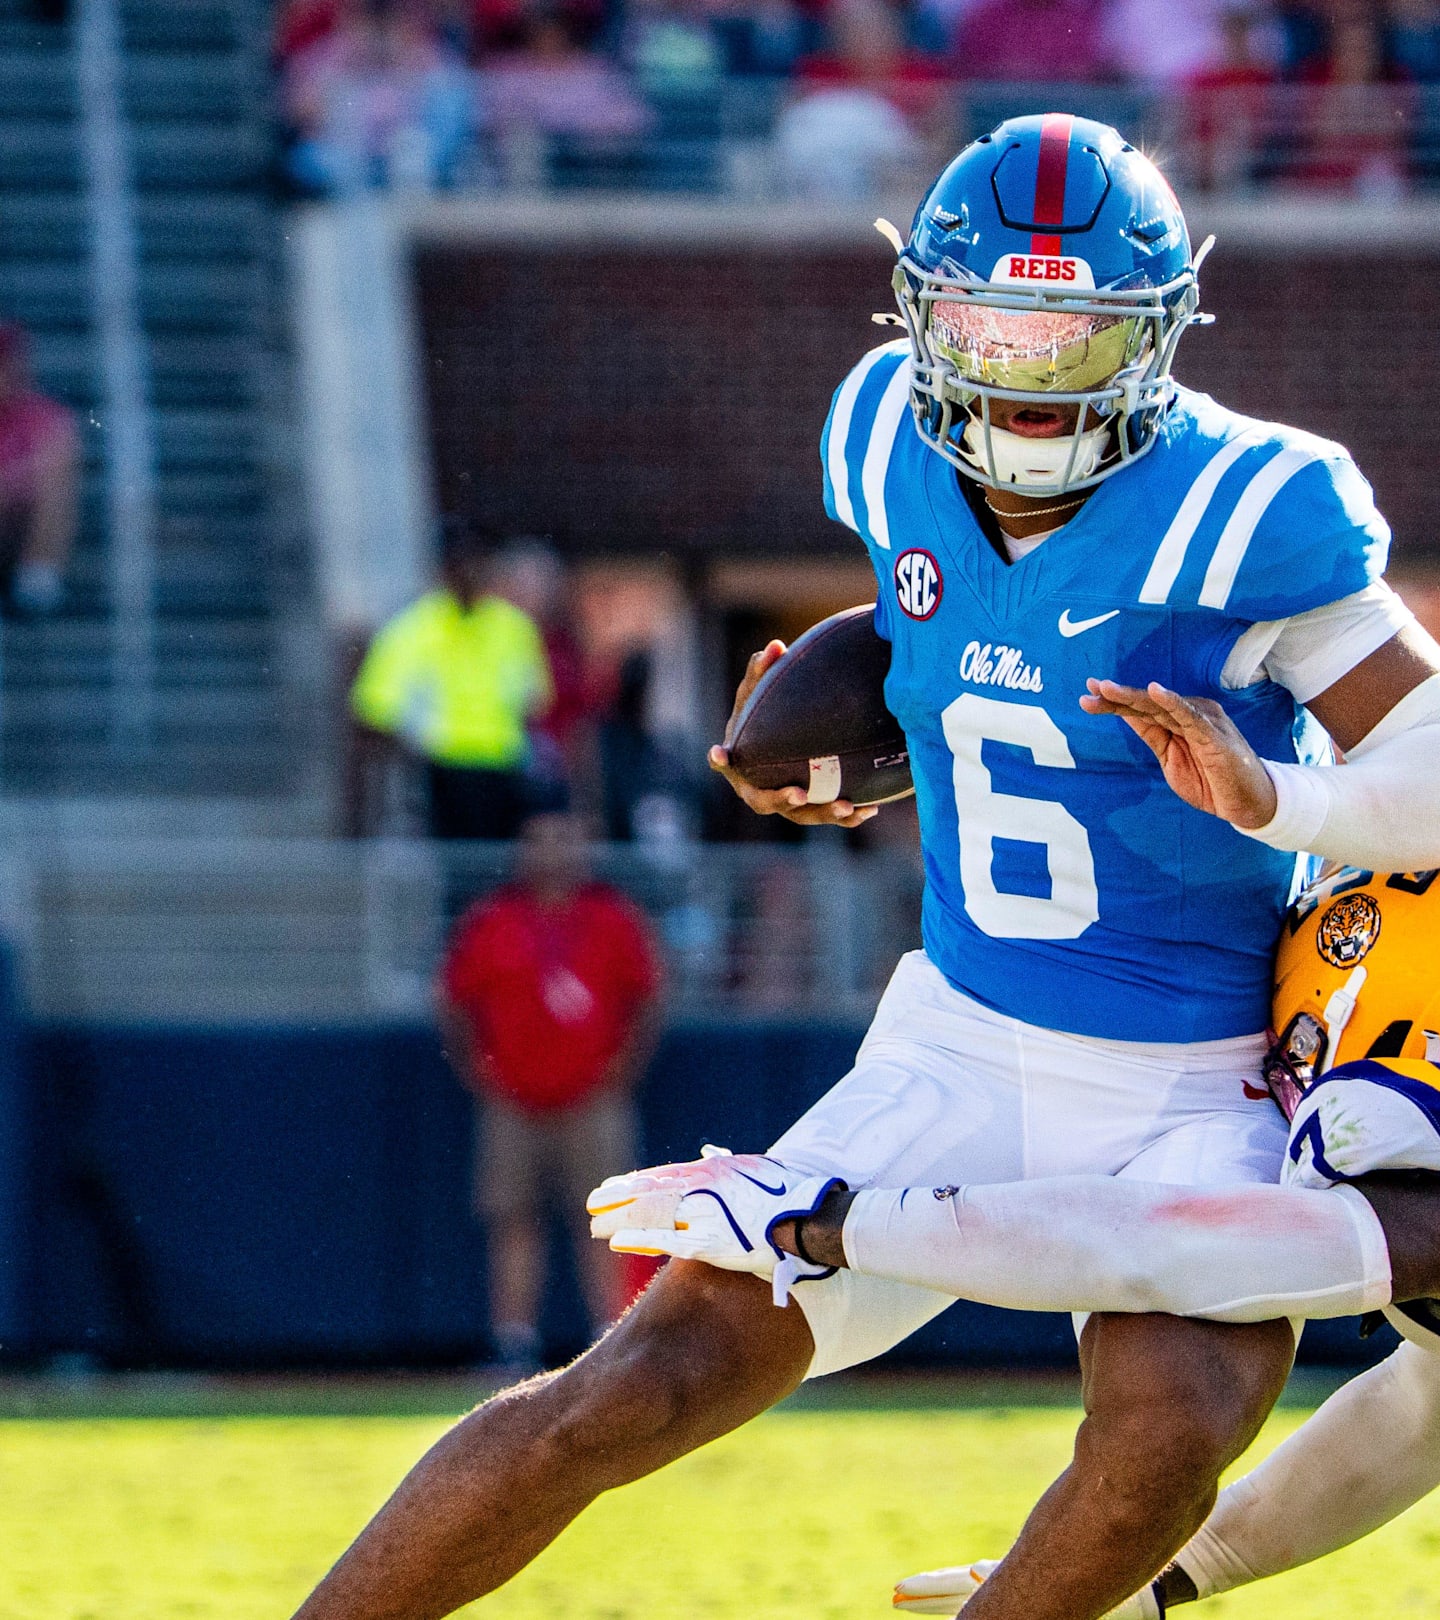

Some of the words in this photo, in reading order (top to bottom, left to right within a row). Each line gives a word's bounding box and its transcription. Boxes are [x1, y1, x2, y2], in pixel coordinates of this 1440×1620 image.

[1008, 257, 1076, 281] REBS
[896, 552, 939, 616] SEC
[959, 640, 994, 684] Ole
[990, 645, 1044, 693] Miss
[941, 692, 1100, 940] 6
[1289, 1107, 1346, 1181] 7
